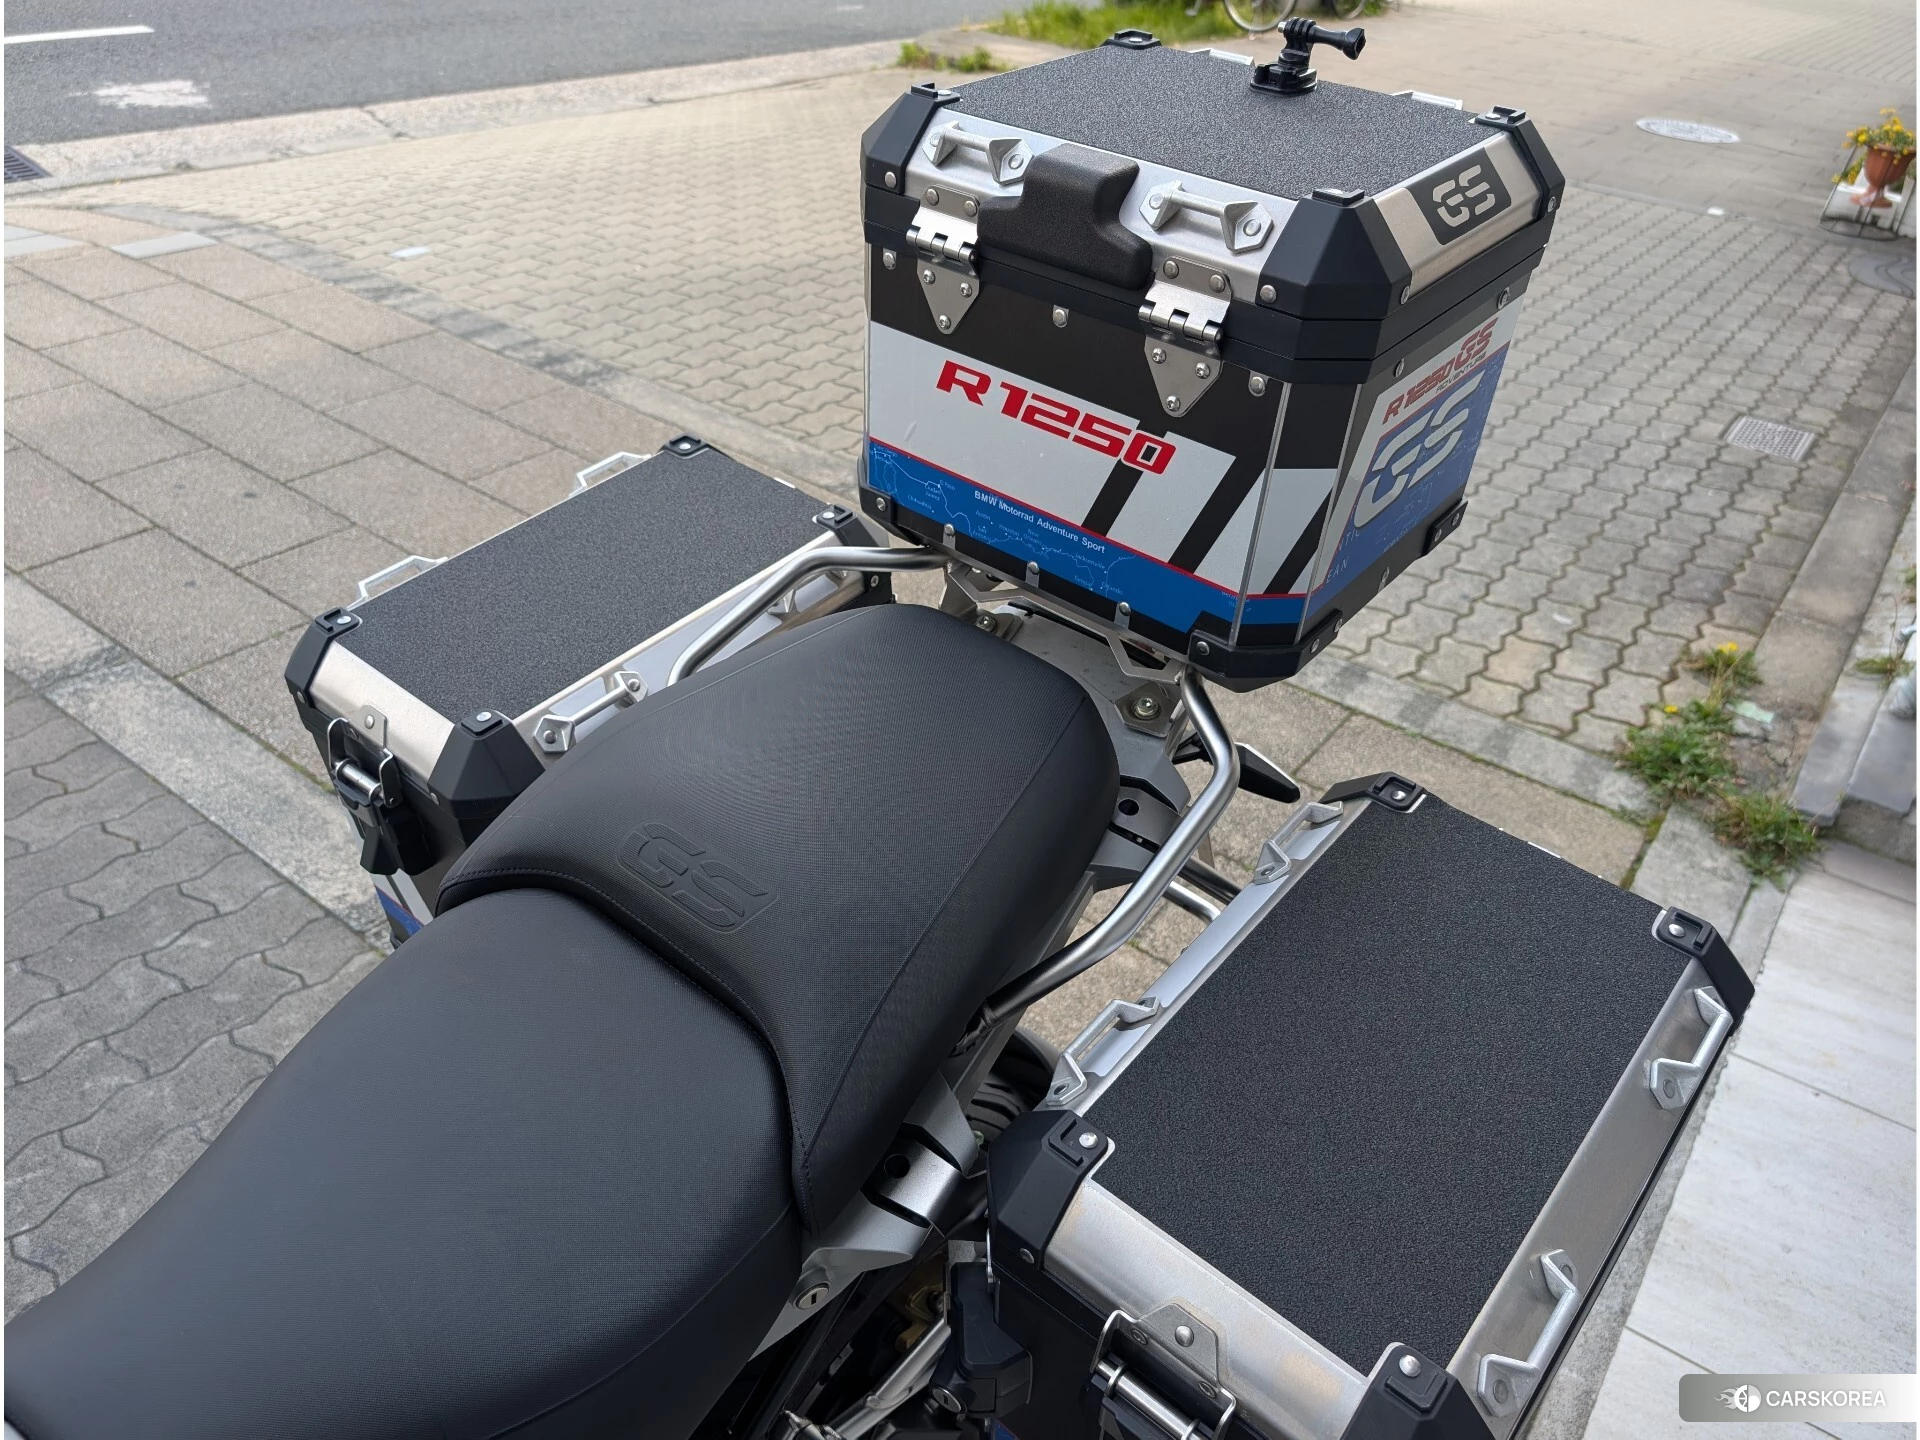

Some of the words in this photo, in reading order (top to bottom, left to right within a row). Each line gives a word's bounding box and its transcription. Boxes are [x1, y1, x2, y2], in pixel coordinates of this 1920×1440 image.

[1432, 164, 1496, 228] GS
[936, 360, 992, 407] R
[1000, 381, 1177, 475] 1250
[1382, 393, 1405, 425] R
[1404, 357, 1456, 410] 1250
[1454, 317, 1499, 371] GS
[1435, 351, 1487, 394] ADVENTURE
[1353, 369, 1486, 528] GS
[974, 490, 998, 507] BMW
[998, 500, 1035, 523] Motorrad
[1036, 517, 1079, 542] Adventure
[1081, 536, 1106, 554] Sport
[618, 821, 770, 928] GS
